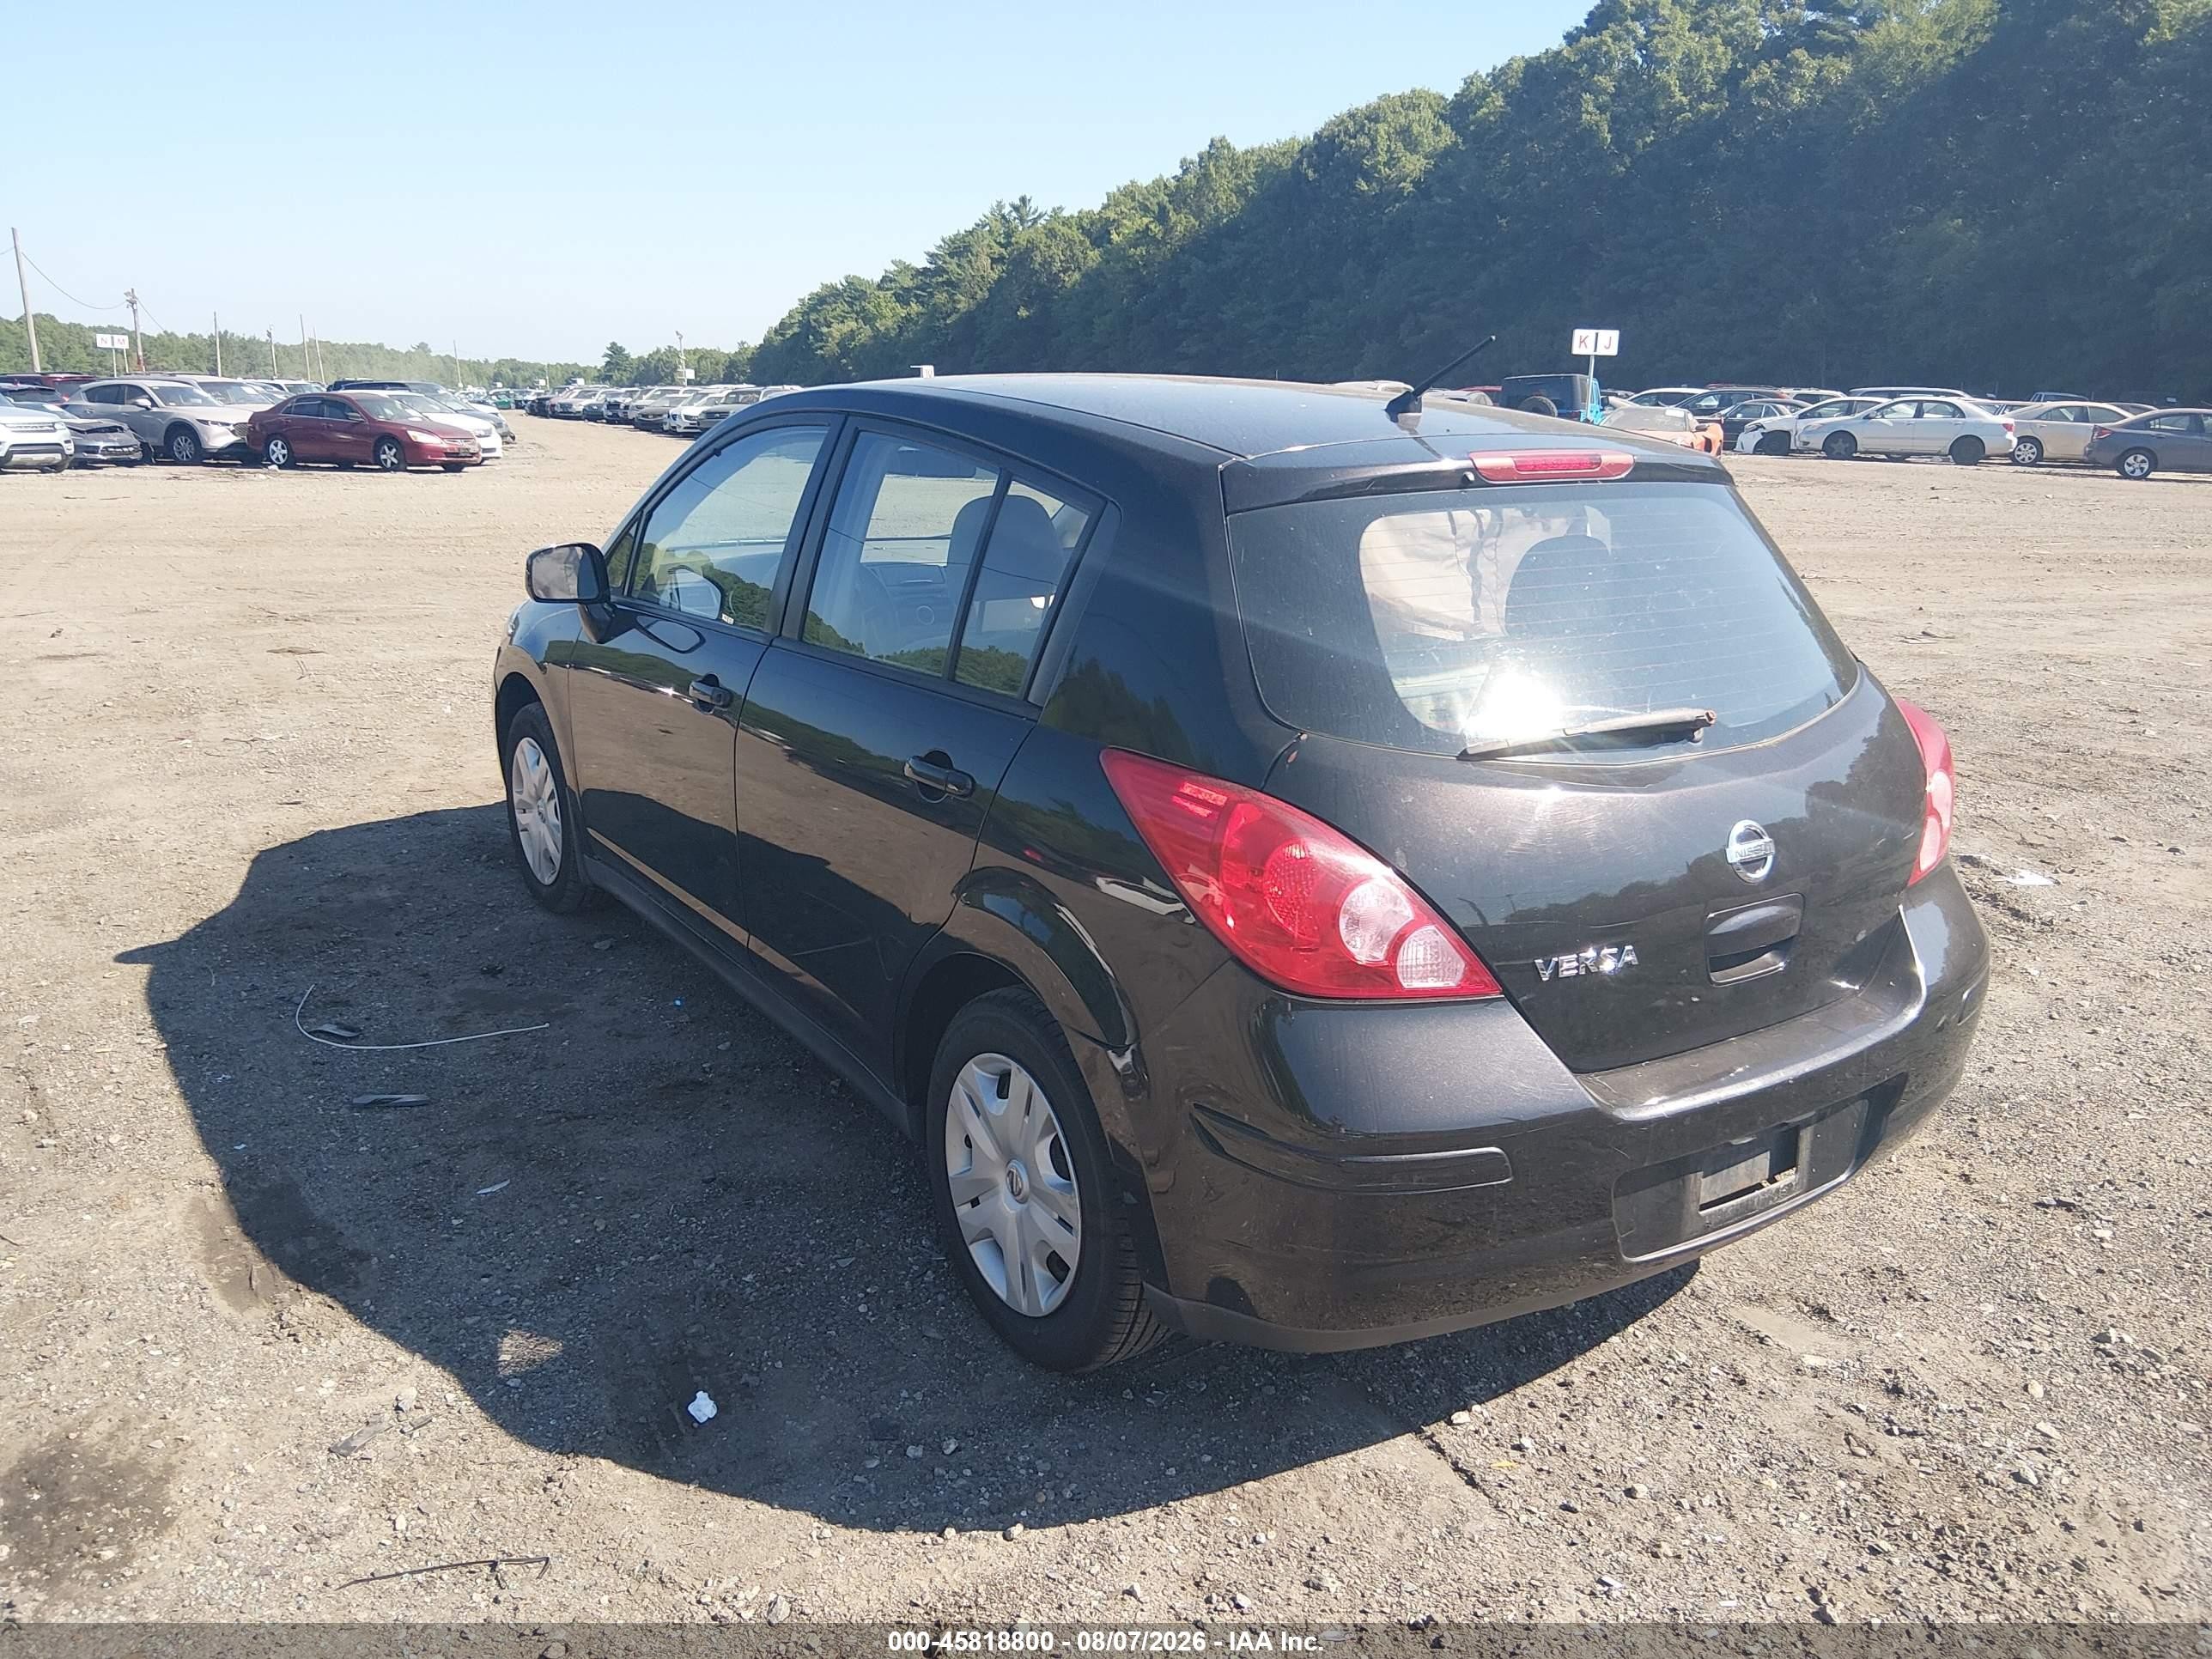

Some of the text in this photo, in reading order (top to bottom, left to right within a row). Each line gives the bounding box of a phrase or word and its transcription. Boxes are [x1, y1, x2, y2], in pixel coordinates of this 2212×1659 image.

[1578, 334, 1613, 350] K J
[1534, 945, 1639, 981] VERSA
